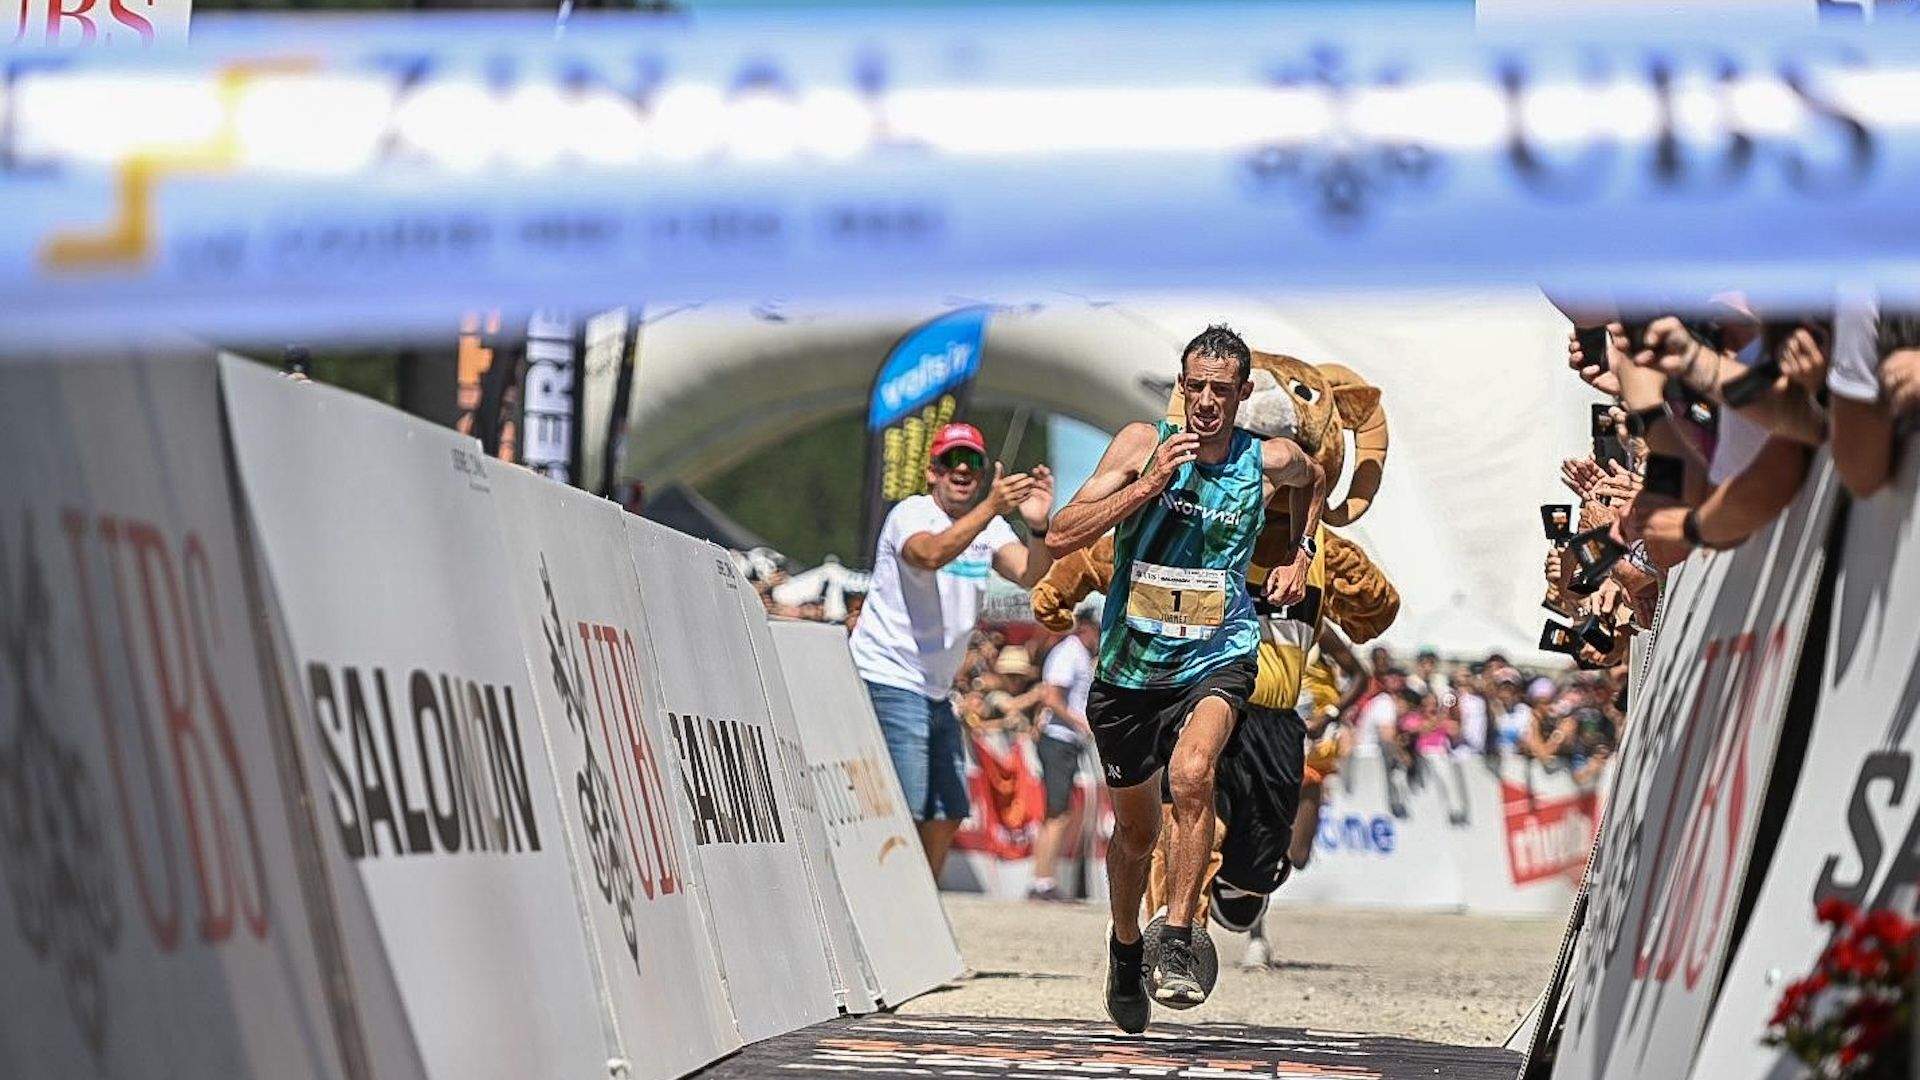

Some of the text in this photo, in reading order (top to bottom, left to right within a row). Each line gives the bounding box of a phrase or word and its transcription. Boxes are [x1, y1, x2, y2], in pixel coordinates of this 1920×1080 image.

[1171, 590, 1181, 612] 1
[60, 505, 272, 955] UBS
[307, 660, 542, 857] SALOMON
[577, 621, 684, 901] UBS
